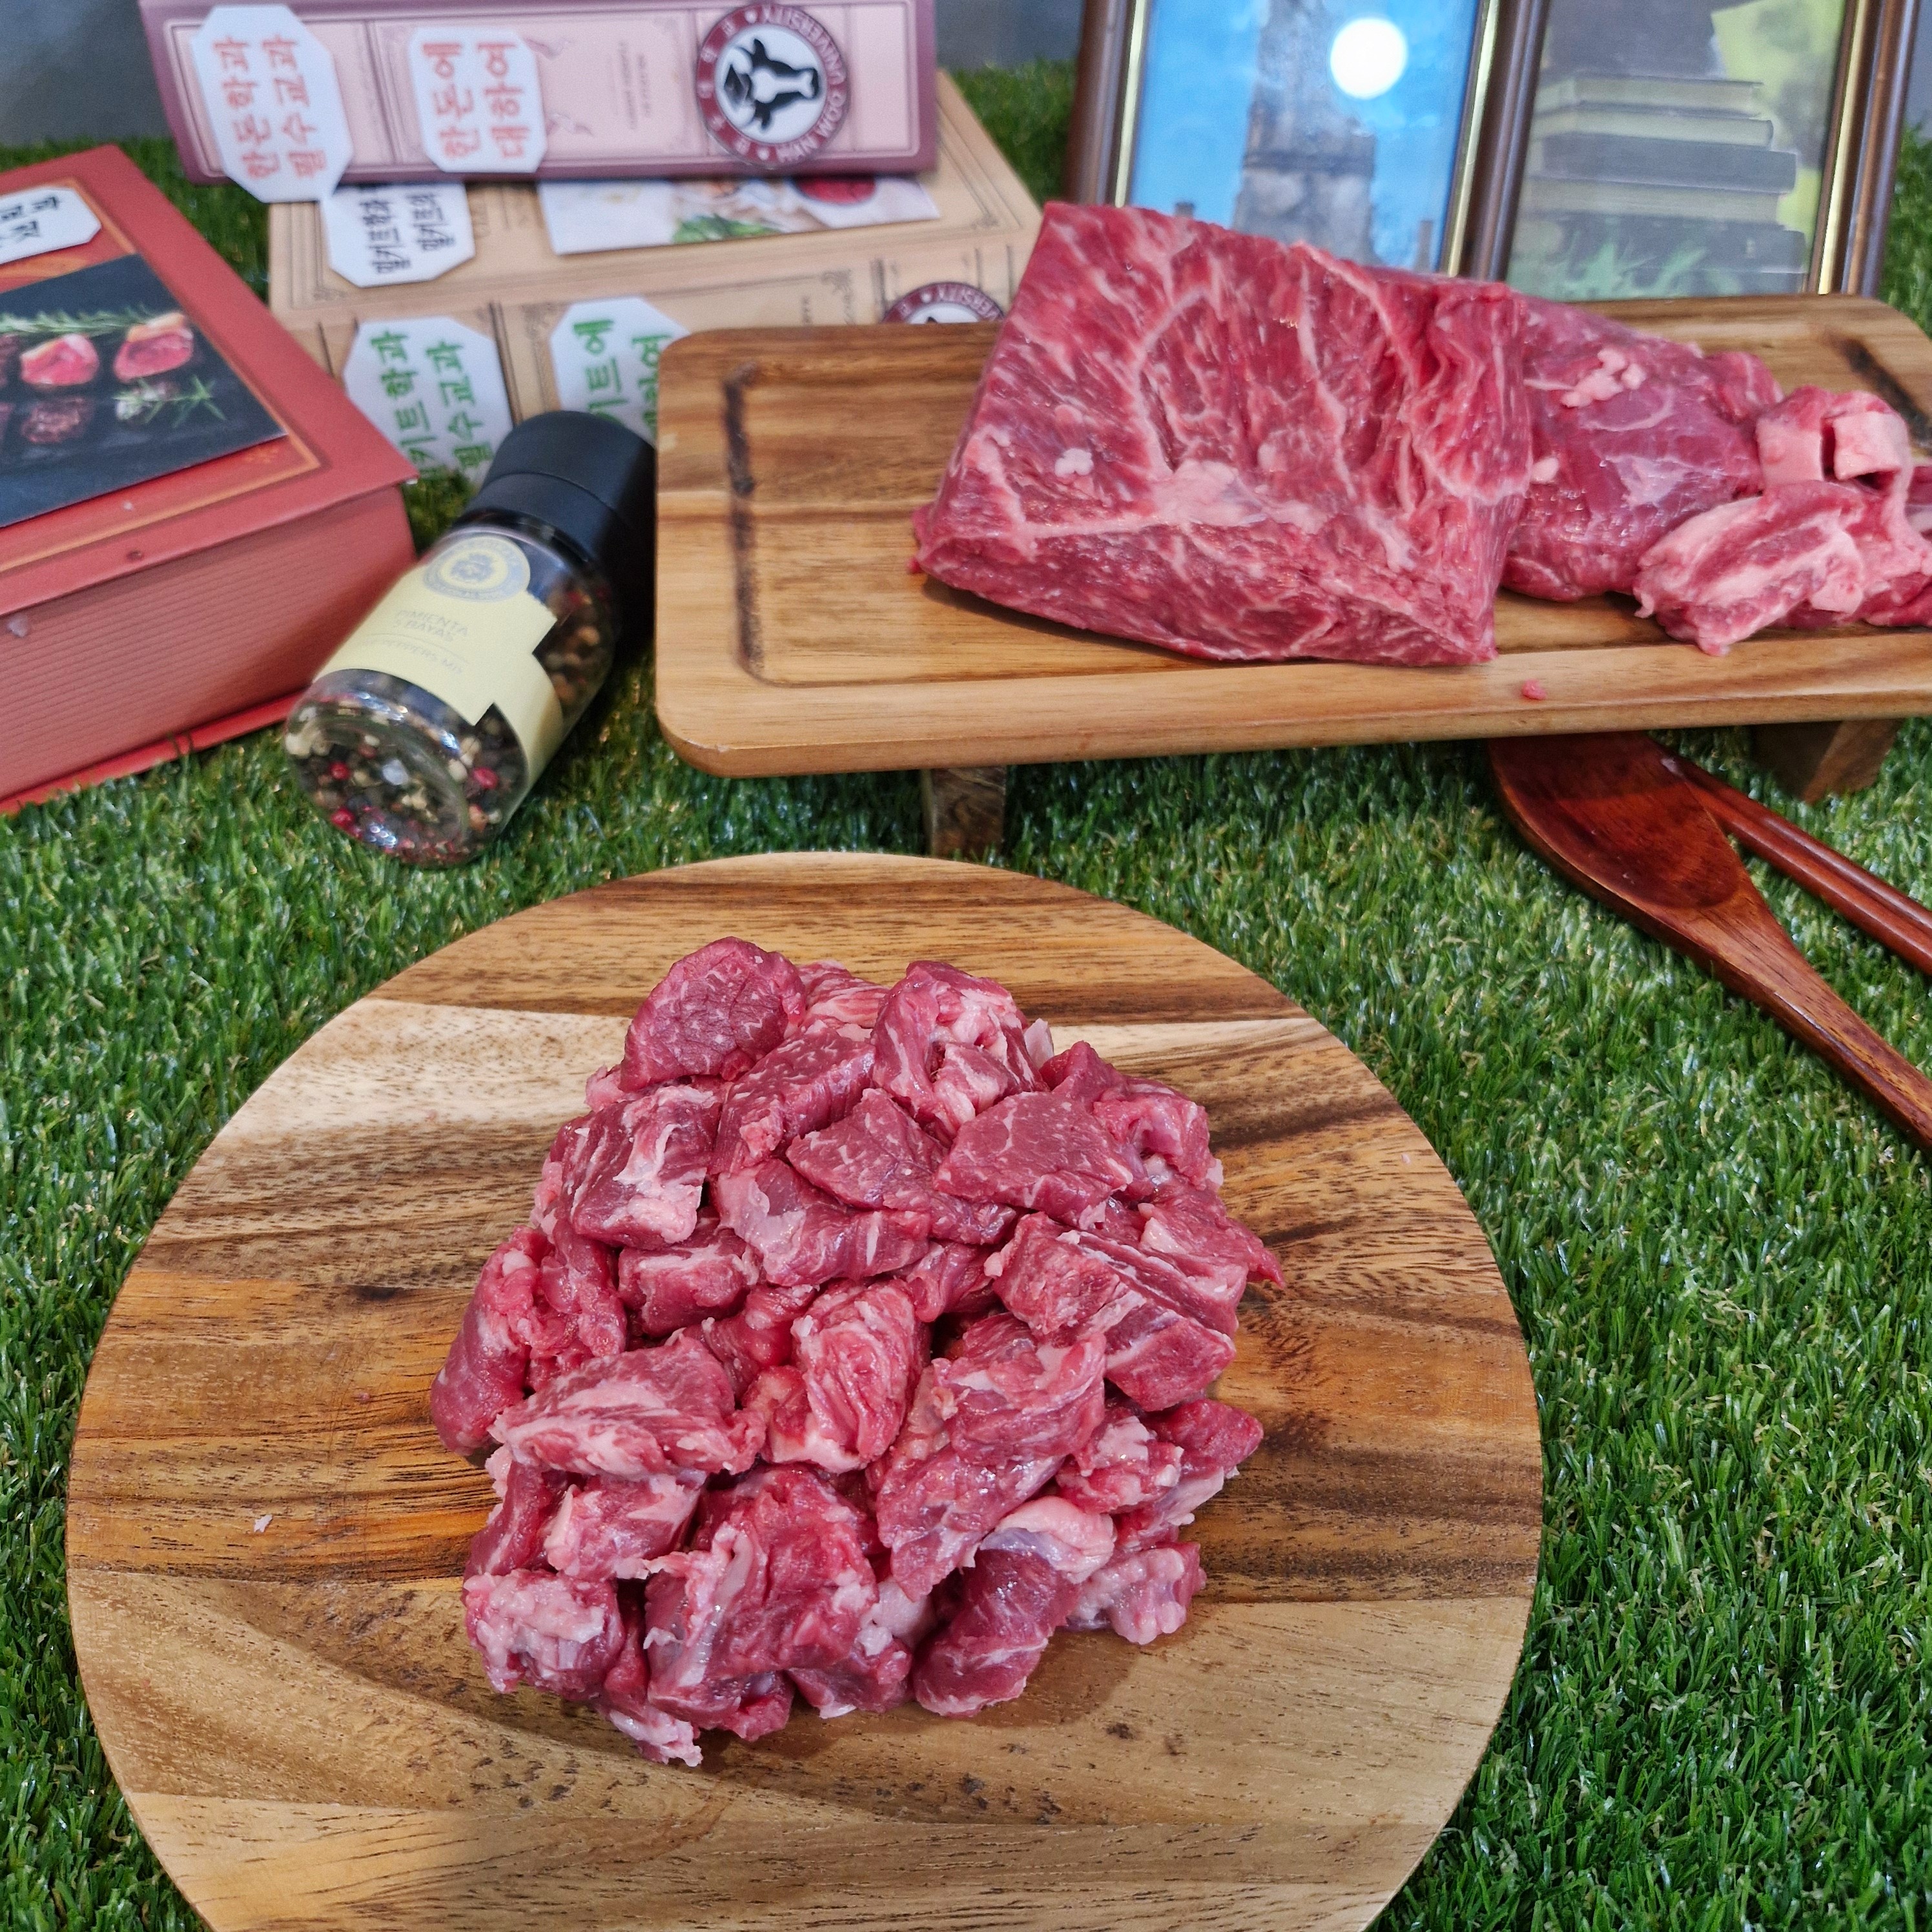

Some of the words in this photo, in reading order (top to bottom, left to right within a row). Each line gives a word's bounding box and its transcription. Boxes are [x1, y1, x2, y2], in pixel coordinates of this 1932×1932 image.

[213, 36, 280, 180] 한돈학과
[262, 35, 325, 178] 필수교과
[422, 41, 482, 158] 한돈에
[477, 41, 529, 159] 대하여
[426, 341, 493, 473] 필수교과
